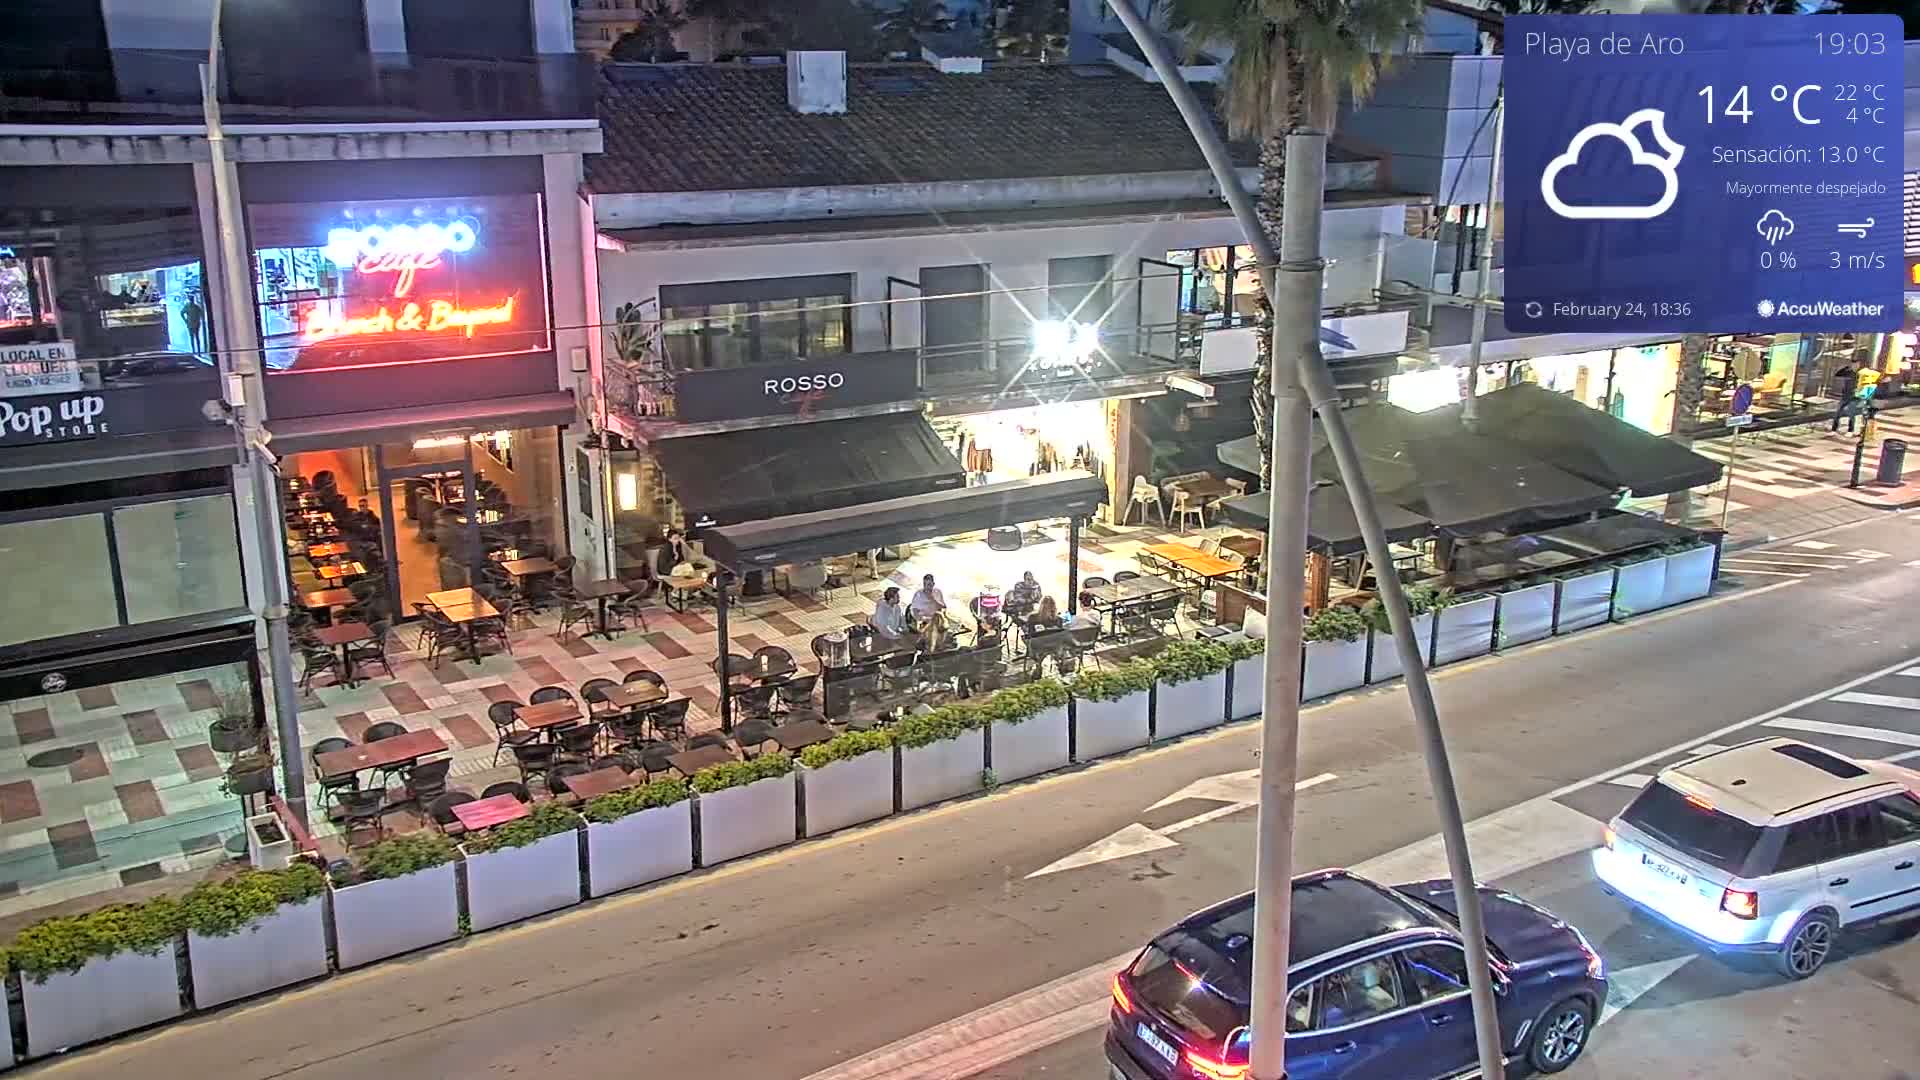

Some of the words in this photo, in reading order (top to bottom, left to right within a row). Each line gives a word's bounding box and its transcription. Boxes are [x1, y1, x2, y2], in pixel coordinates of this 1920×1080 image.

[1, 349, 46, 363] LOCAL
[48, 347, 66, 360] EN
[764, 373, 844, 395] ROSSO
[60, 396, 104, 425] up
[45, 422, 109, 438] STORE
